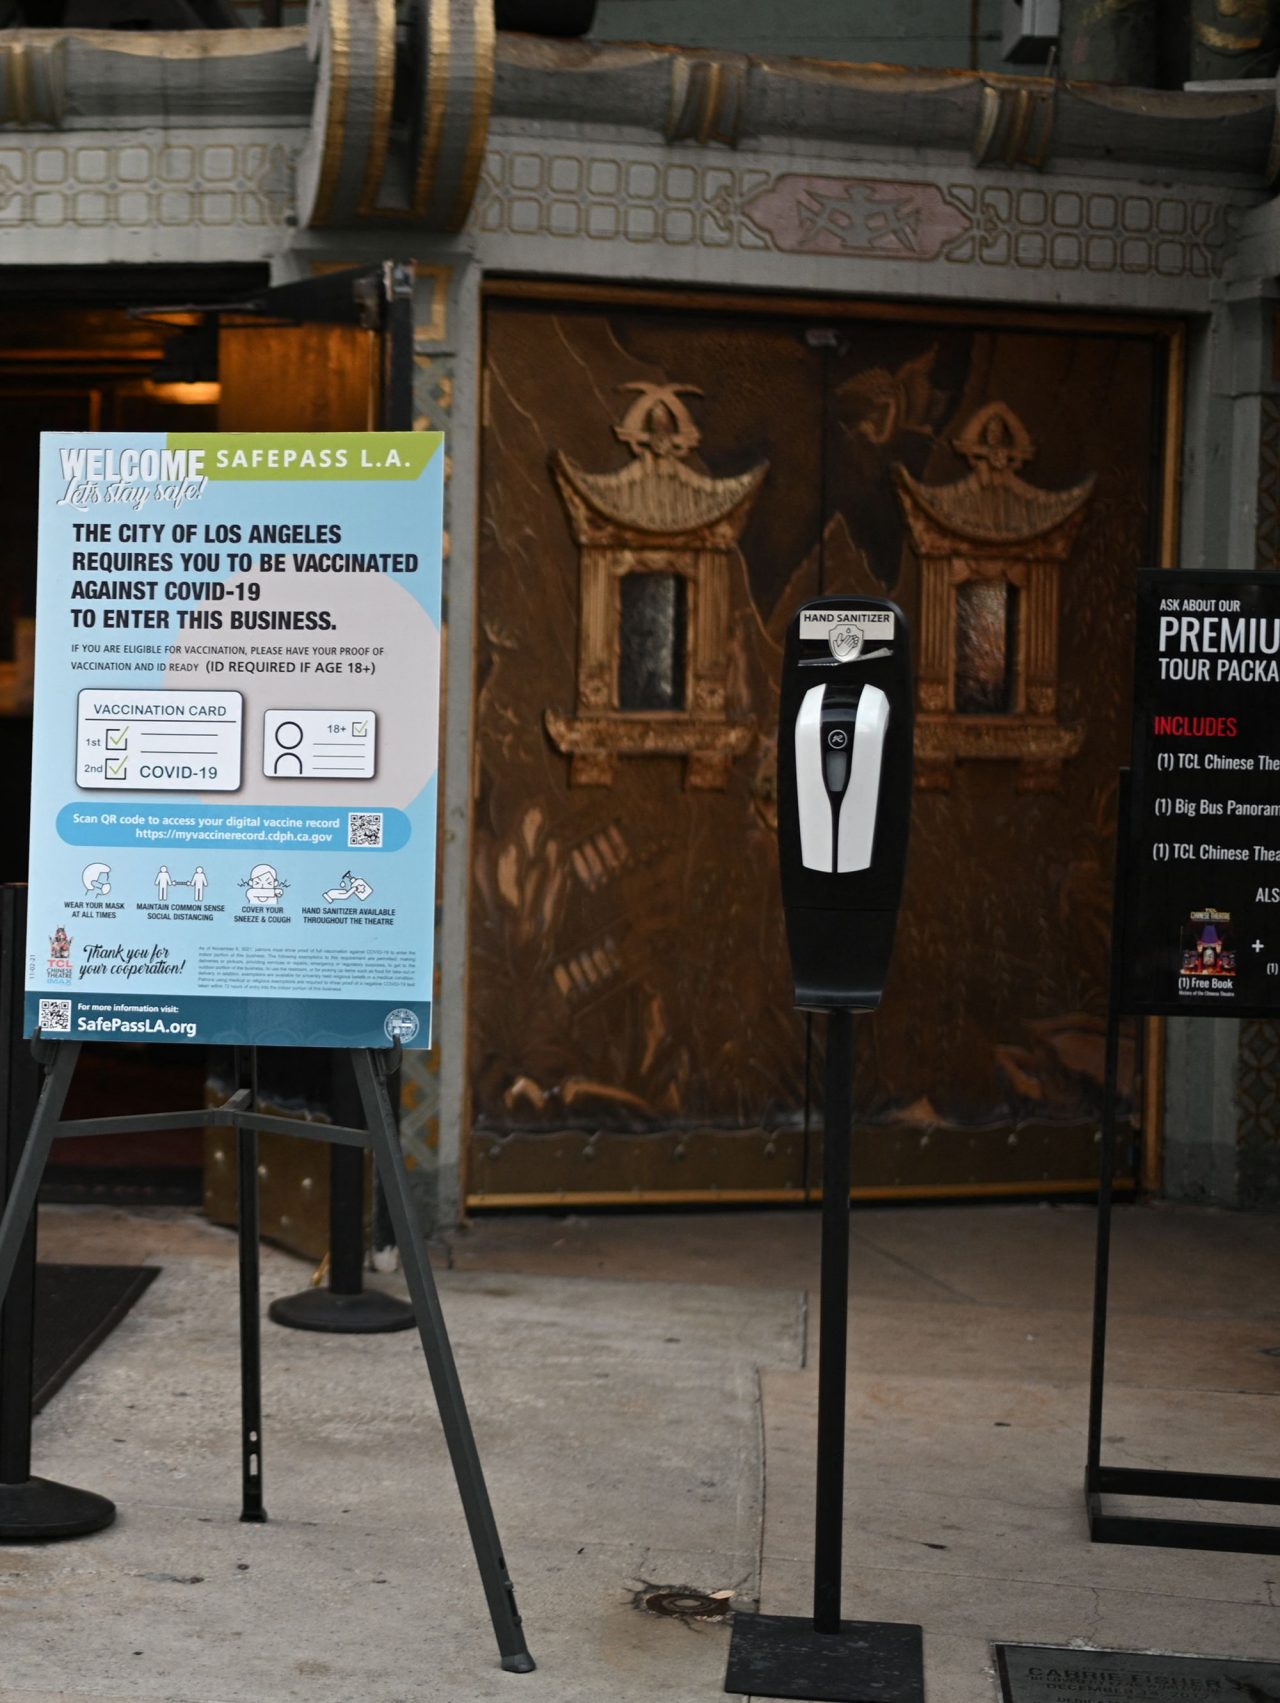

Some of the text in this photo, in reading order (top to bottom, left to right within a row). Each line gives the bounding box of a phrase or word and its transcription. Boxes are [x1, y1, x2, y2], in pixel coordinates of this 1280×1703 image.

[60, 448, 206, 482] WELCOME
[216, 449, 412, 468] SAFEPASS L.A.
[57, 476, 208, 511] Let's stay safe!
[72, 524, 342, 544] THE CITY OF LOS ANGELES
[72, 553, 418, 573] REQUIRES YOU TO BE VACCINATED
[71, 581, 260, 601] AGAINST COVID-19
[1160, 599, 1240, 612] ASK ABOUT OUR
[71, 610, 336, 631] TO ENTER THIS BUSINESS.
[804, 613, 890, 622] HAND SANITIZER
[1159, 616, 1280, 654] PREMIU
[71, 644, 384, 657] IF YOU ARE ELIGIBLE FOR VACCINATION, PLEASE HAVE YOUR PROOF OF
[71, 660, 376, 676] VACCINATION AND ID READY (ID REQUIRED IF AGE 18+)
[1159, 658, 1210, 680] TOUR
[94, 704, 227, 717] VACCINATION CARD
[327, 724, 347, 735] 18+
[1154, 716, 1238, 737] INCLUDES
[85, 738, 101, 748] 1st
[84, 763, 103, 774] 2nd
[1158, 753, 1174, 771] (1)
[1178, 754, 1200, 768] TCL
[1204, 754, 1254, 770] Chinese
[140, 765, 218, 780] COVID-19
[1155, 798, 1172, 816] (1)
[1175, 799, 1196, 817] Big
[1200, 800, 1224, 814] Bus
[73, 813, 340, 830] Scan QR code to access your digital vaccine record
[135, 828, 333, 845] https://myvaccinerecord.cdph.ca.gov
[1153, 843, 1170, 861] (1)
[1173, 844, 1196, 858] TCL
[1200, 844, 1249, 860] Chinese
[64, 901, 125, 911] WEAR YOUR MASK
[137, 903, 225, 913] MAINTAIN COMMON SENSE
[241, 905, 284, 915] COVER YOUR
[302, 907, 396, 917] HAND SANITIZER AVAILABLE
[72, 911, 116, 919] AT ALL TIMES
[147, 912, 214, 922] SOCIAL DISTANCING
[233, 915, 291, 924] SNEEZE & COUGH
[303, 916, 394, 925] THROUGHOUT THE THEATRE
[83, 944, 169, 964] Thank you for
[47, 960, 72, 968] TCL
[78, 965, 107, 980] your
[110, 960, 186, 980] cooperation!
[1266, 963, 1279, 975] (1)
[1178, 978, 1232, 989] (1) Free Book
[78, 1002, 180, 1013] For more information visit:
[77, 1017, 197, 1038] SafePassLA.org
